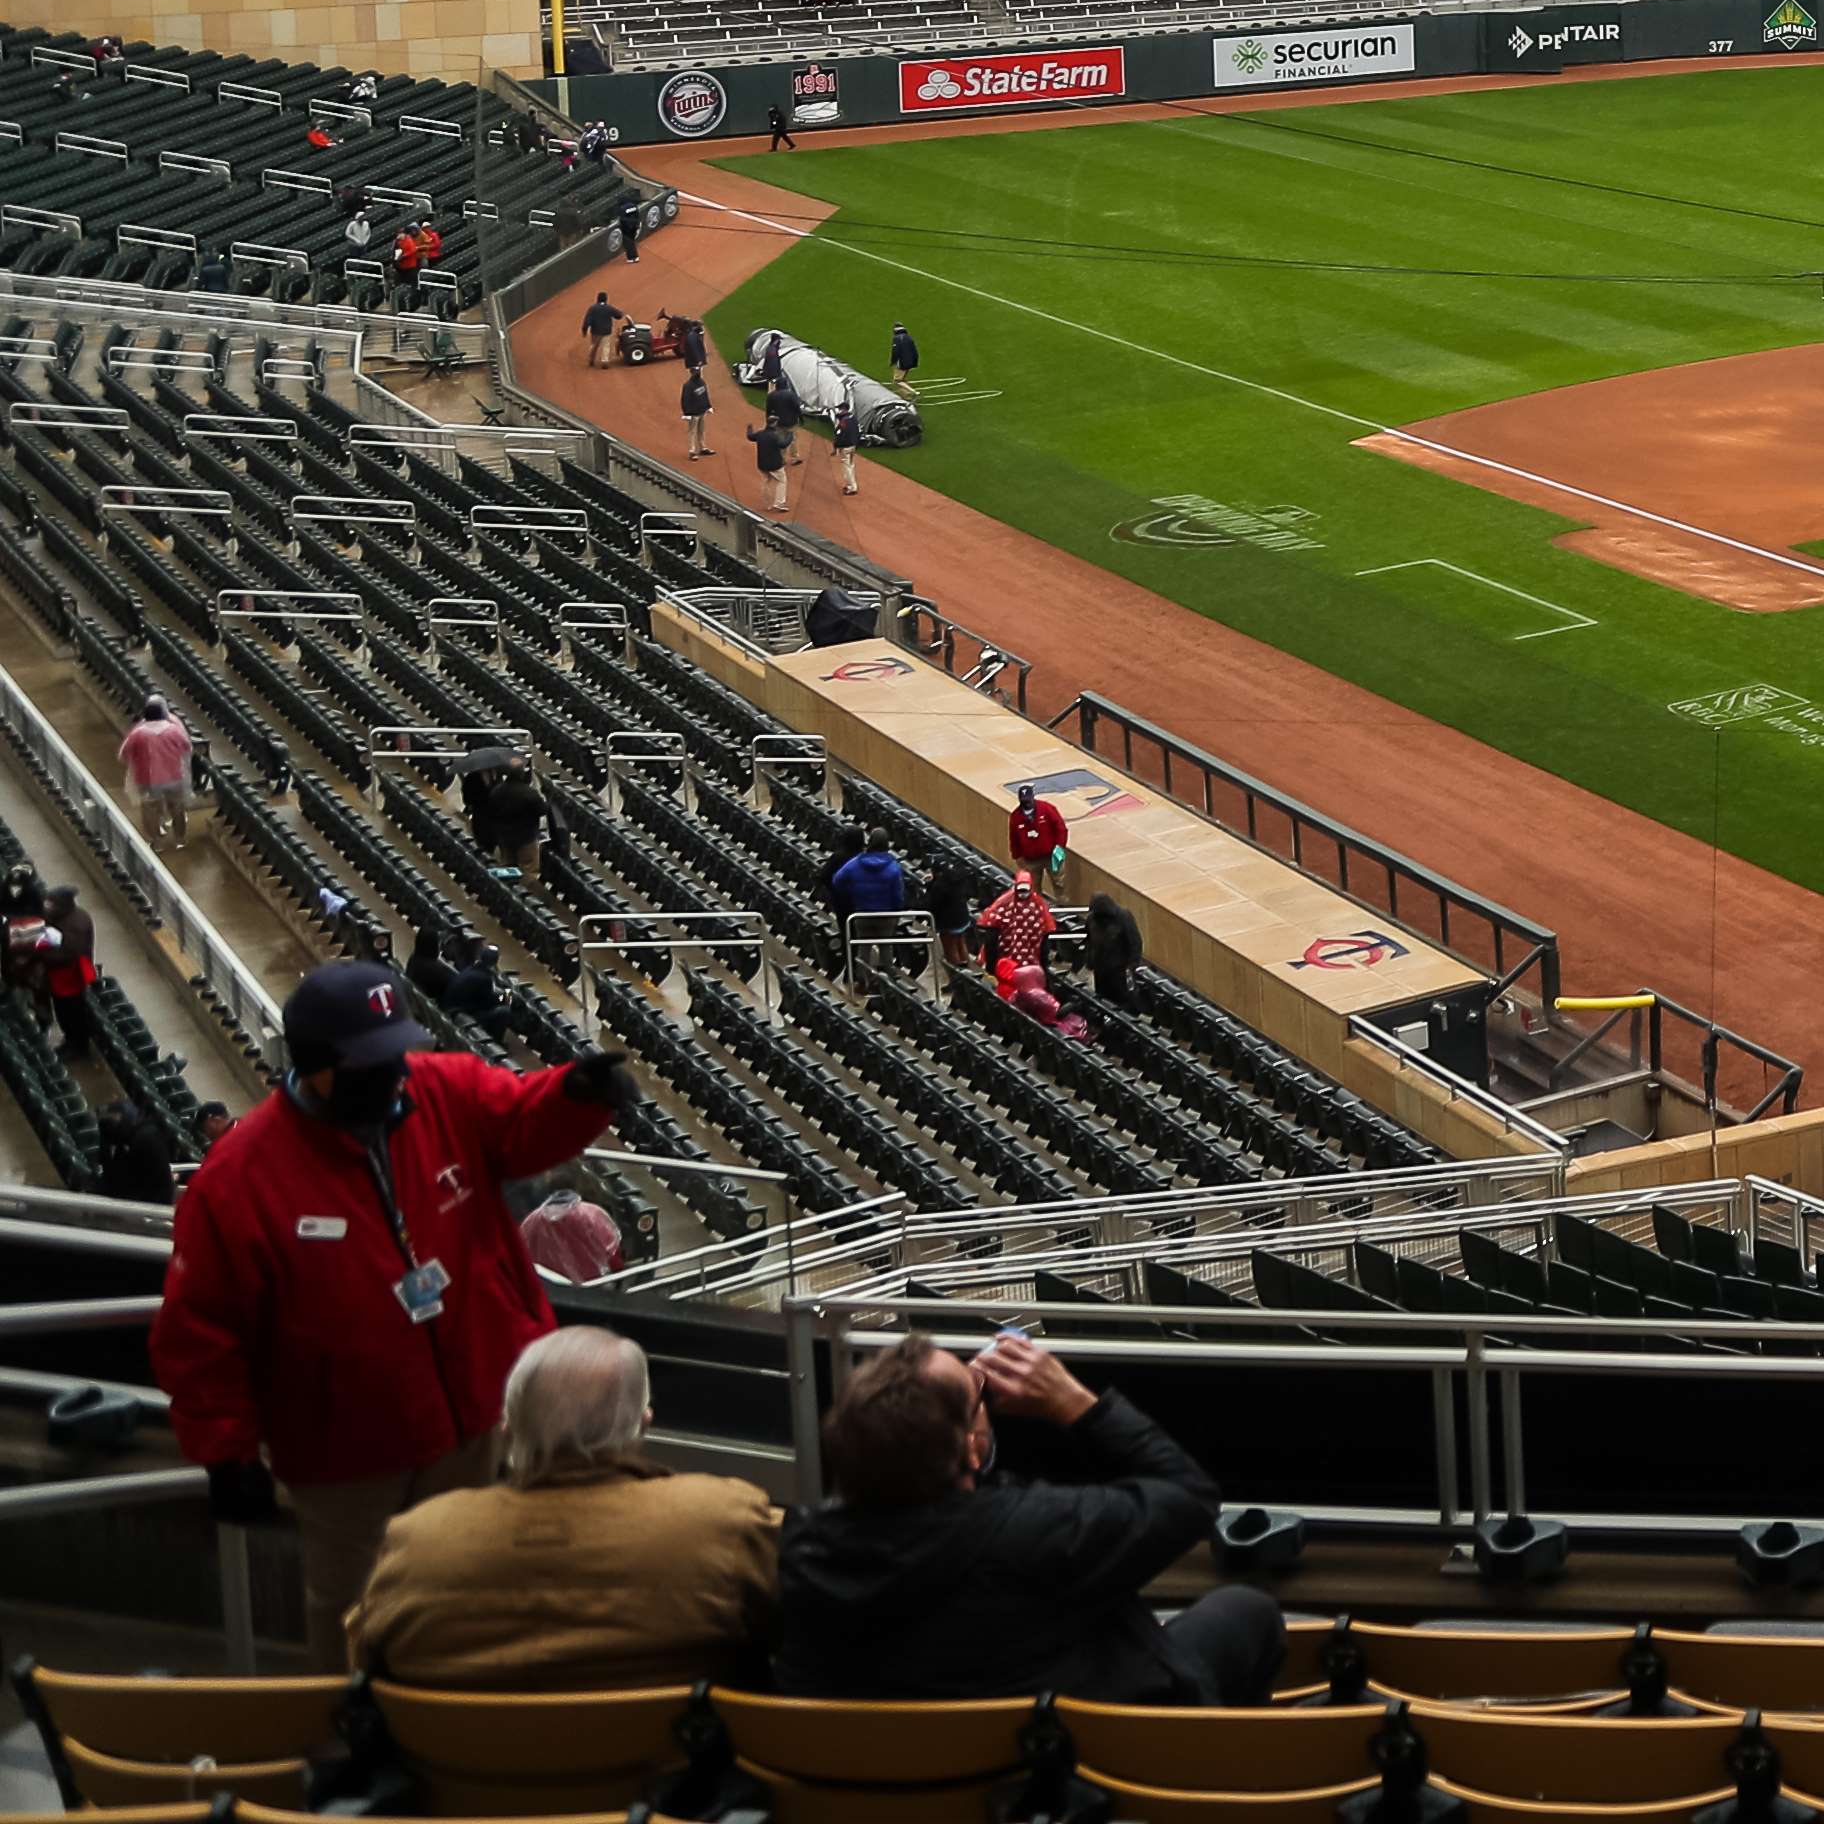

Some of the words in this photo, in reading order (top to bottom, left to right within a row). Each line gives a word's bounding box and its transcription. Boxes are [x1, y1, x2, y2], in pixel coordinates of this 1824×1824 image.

[1764, 24, 1816, 40] SUMMIT
[1274, 32, 1396, 65] securian
[1708, 39, 1734, 52] 377
[1274, 63, 1349, 79] FINANCIAL
[795, 75, 837, 94] 1991
[667, 90, 718, 119] Twins
